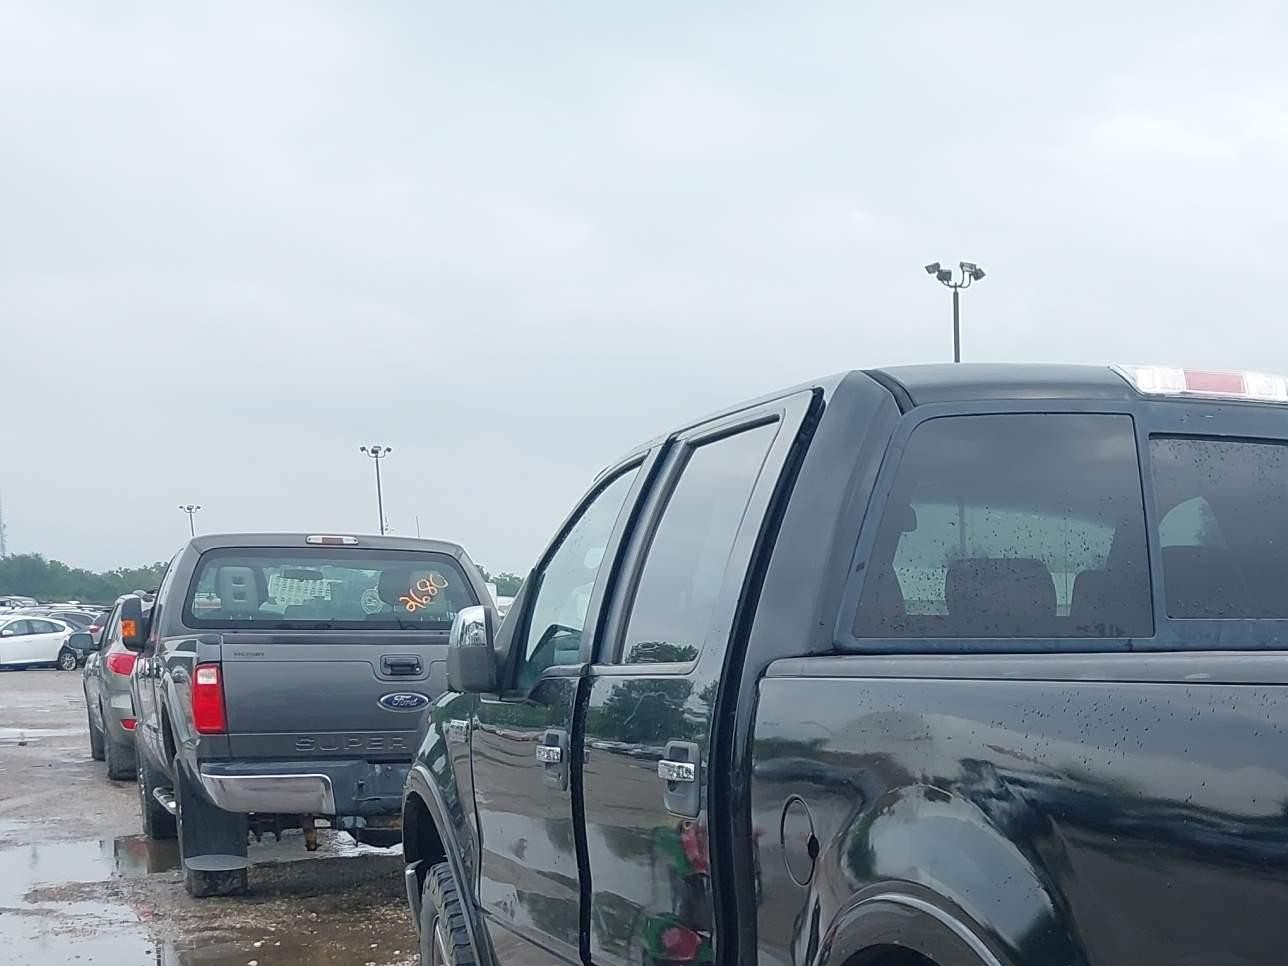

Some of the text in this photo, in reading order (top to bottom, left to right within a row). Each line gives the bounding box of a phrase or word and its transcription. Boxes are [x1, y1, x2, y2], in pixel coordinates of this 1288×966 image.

[398, 573, 450, 613] 2680
[391, 695, 418, 706] Ford
[295, 736, 408, 752] SUPER
